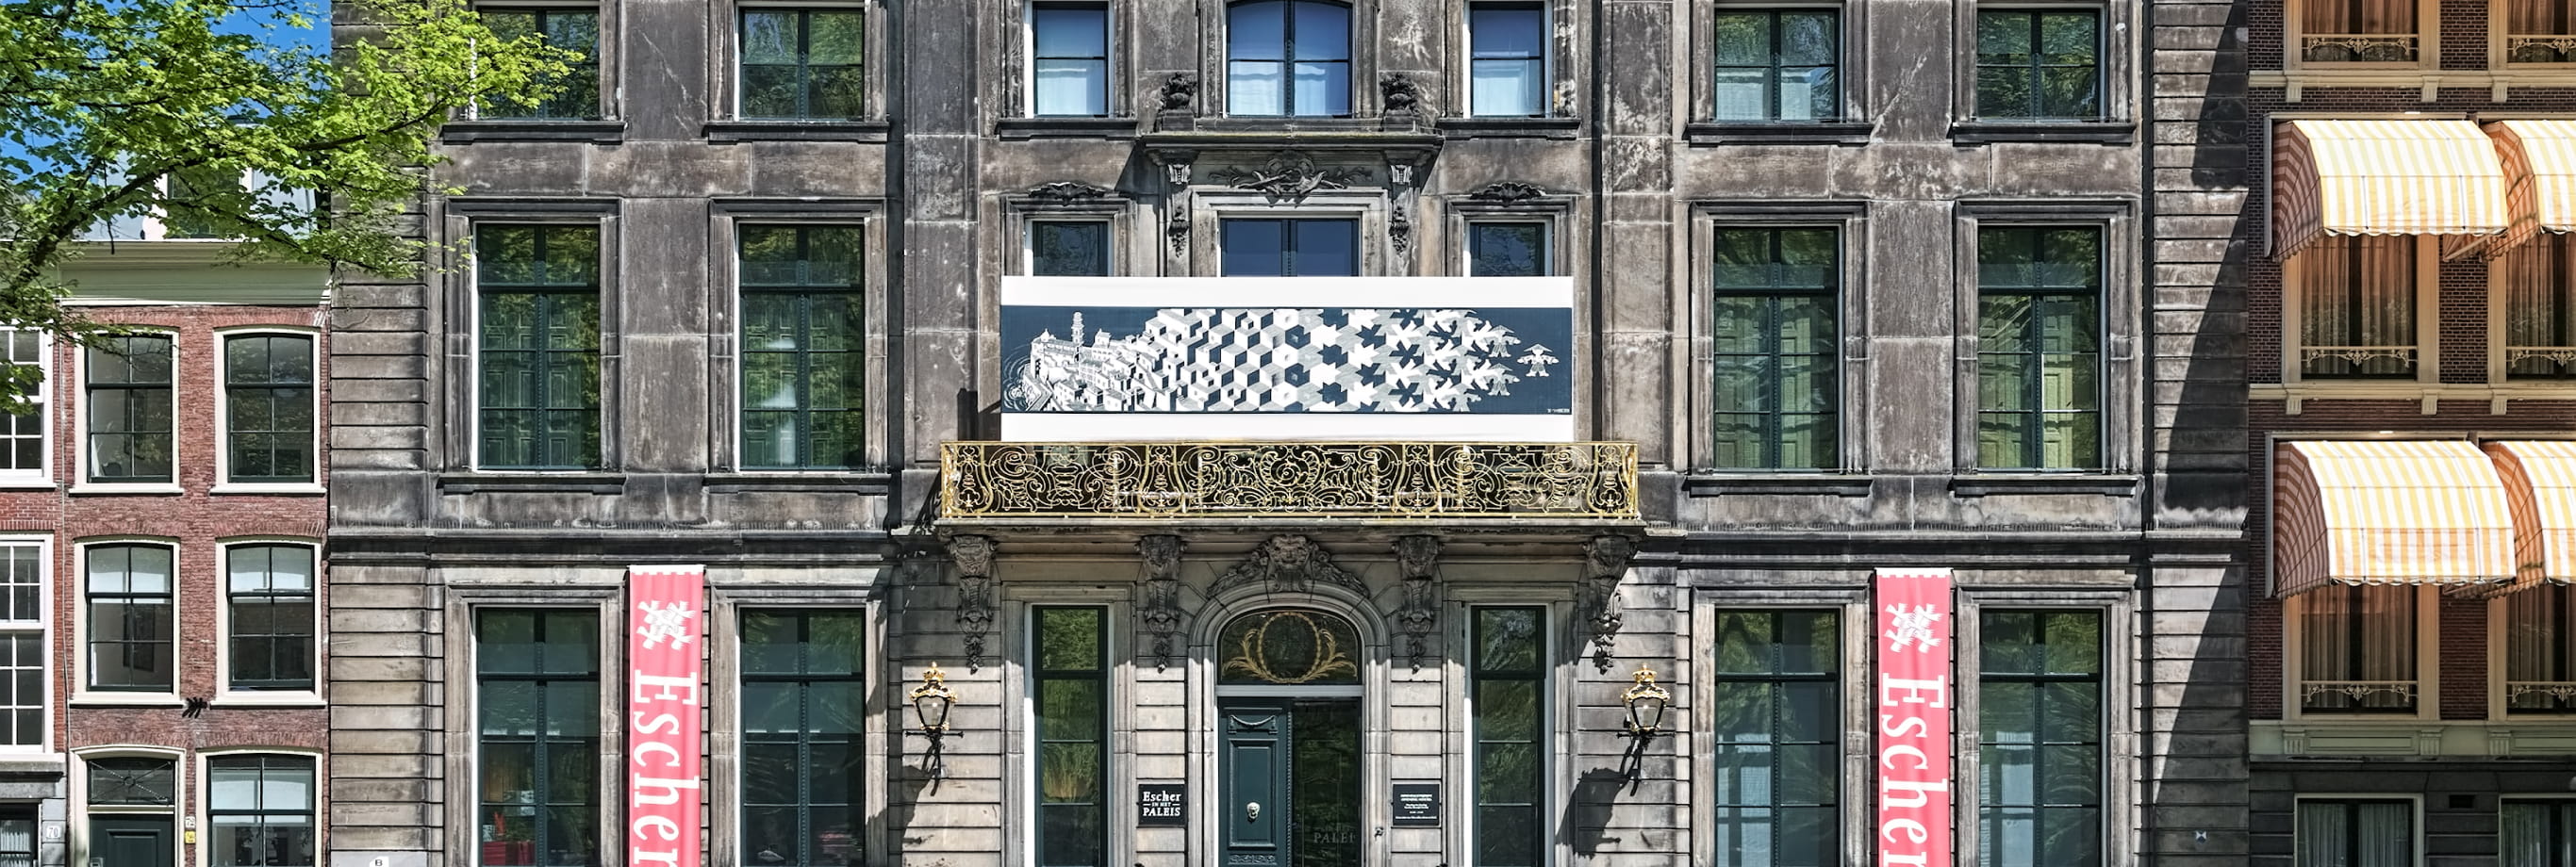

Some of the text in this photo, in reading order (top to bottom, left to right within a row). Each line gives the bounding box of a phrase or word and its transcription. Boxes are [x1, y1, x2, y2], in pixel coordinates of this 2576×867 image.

[633, 669, 700, 867] Escher
[1881, 672, 1948, 867] Escher
[1142, 790, 1181, 802] Escher
[1142, 807, 1181, 816] PALEIS
[48, 826, 58, 838] 70
[1313, 832, 1356, 843] PALEI
